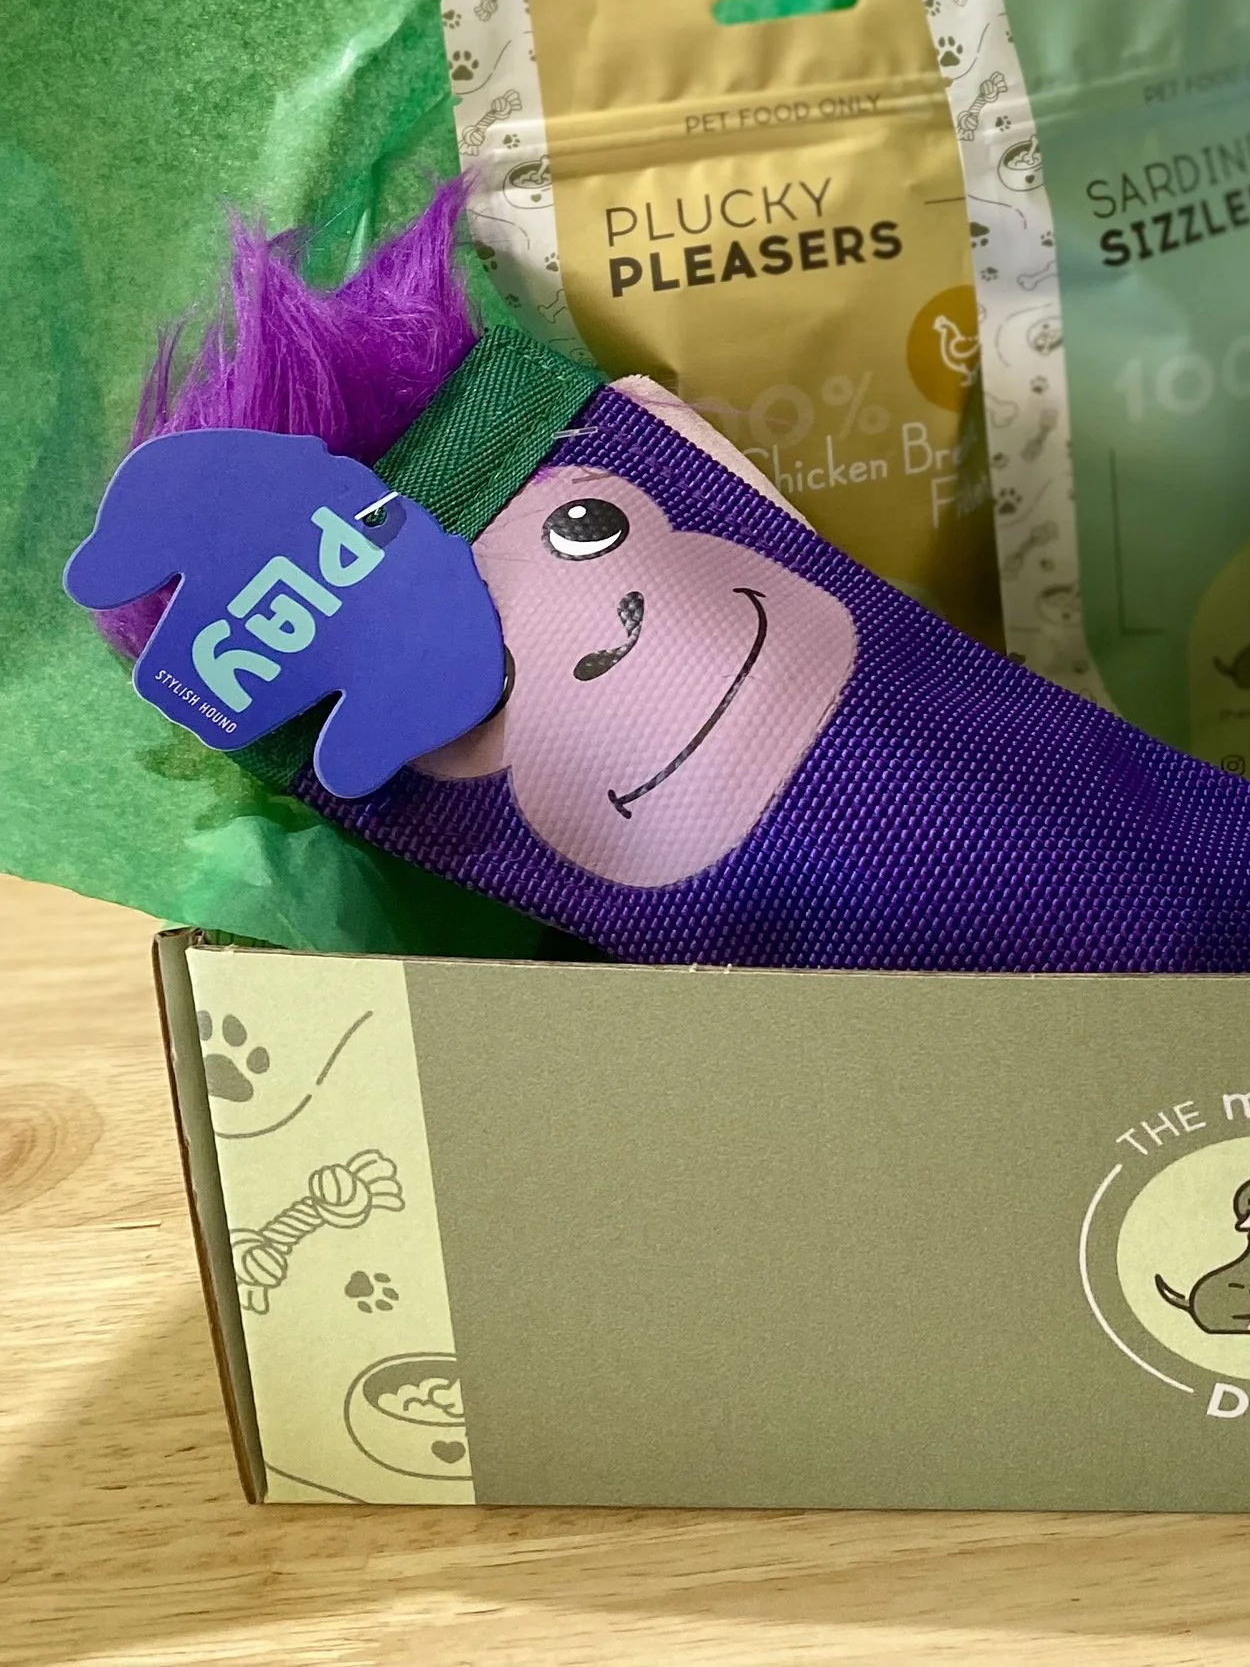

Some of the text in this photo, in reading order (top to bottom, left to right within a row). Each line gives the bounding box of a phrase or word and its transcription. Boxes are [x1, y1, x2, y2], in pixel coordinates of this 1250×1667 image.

[685, 93, 880, 134] PET FOOD ONLY
[605, 177, 831, 247] PLUCKY
[608, 220, 903, 298] PLEASERS
[155, 669, 237, 734] STYLISH HOUND
[1116, 1100, 1207, 1156] THE
